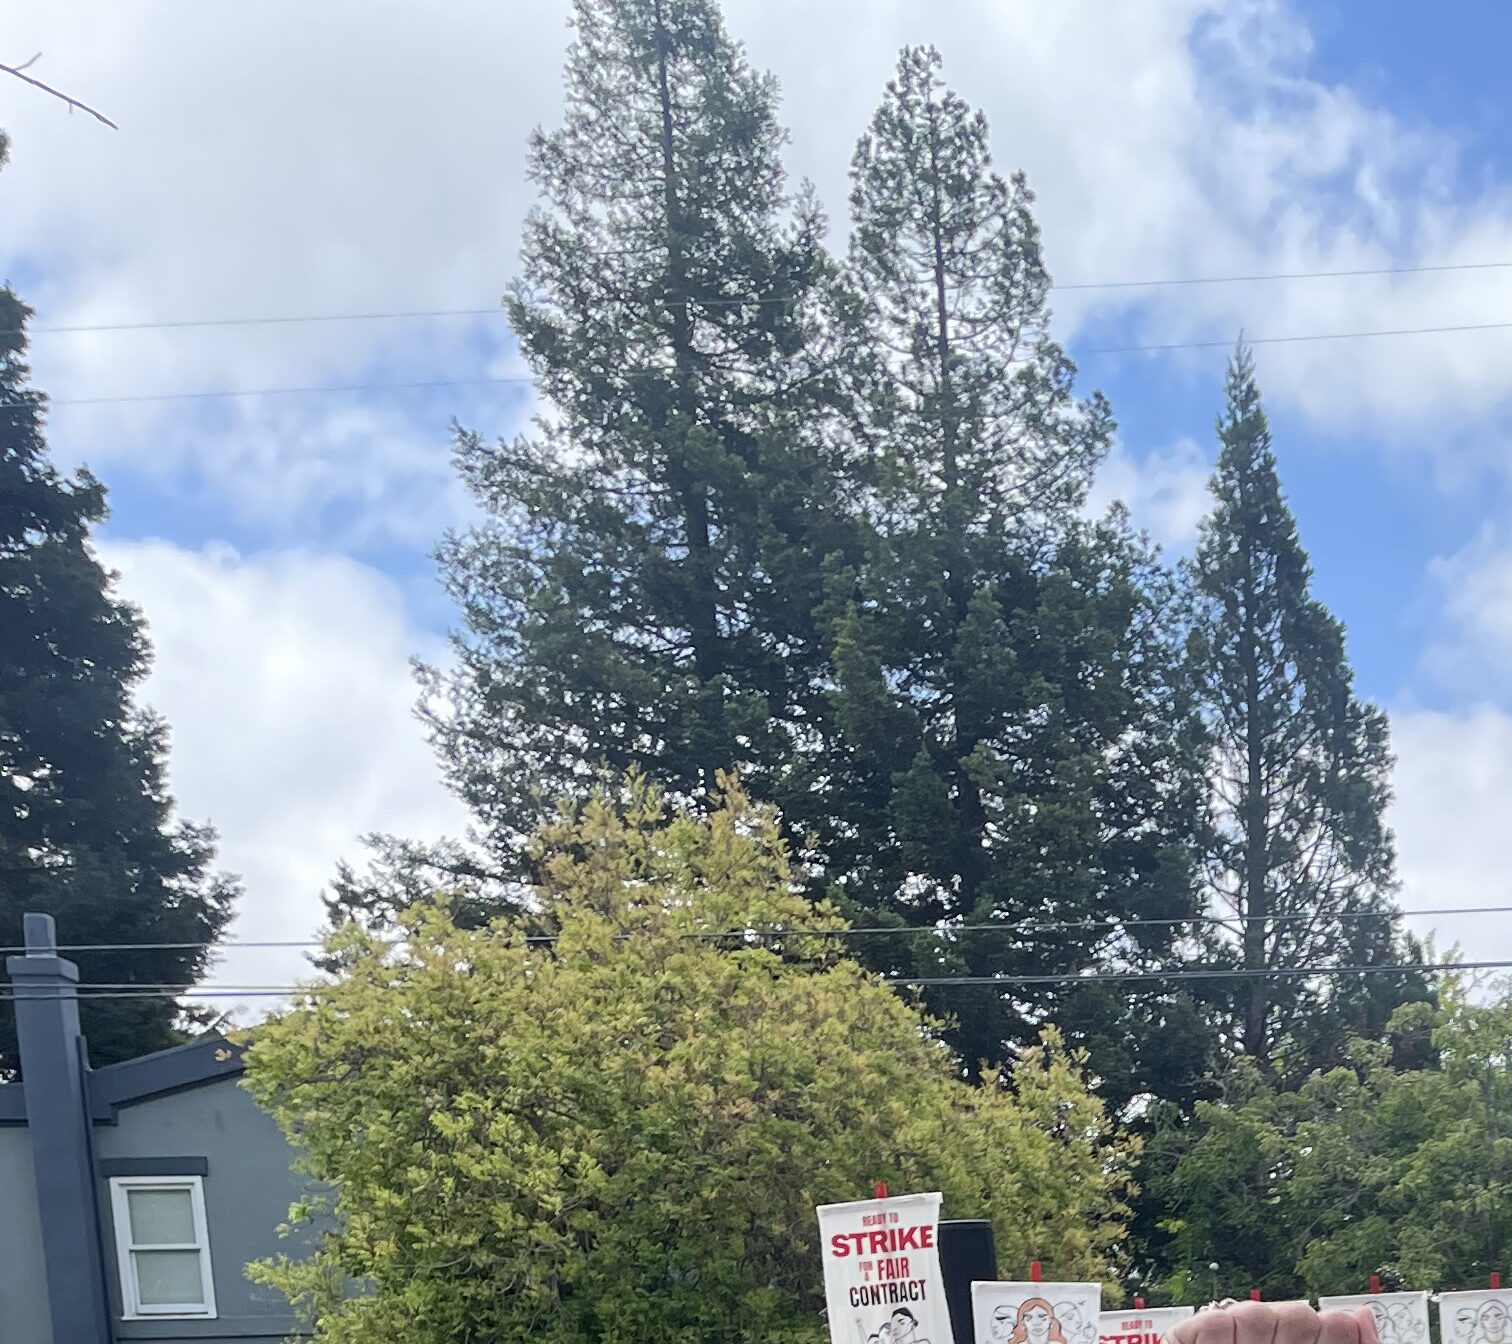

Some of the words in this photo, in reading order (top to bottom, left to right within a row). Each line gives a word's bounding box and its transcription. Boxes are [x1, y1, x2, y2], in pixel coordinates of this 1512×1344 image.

[831, 1225, 934, 1258] STRIKE
[877, 1257, 910, 1281] FAIR
[849, 1279, 926, 1308] CONTRACT
